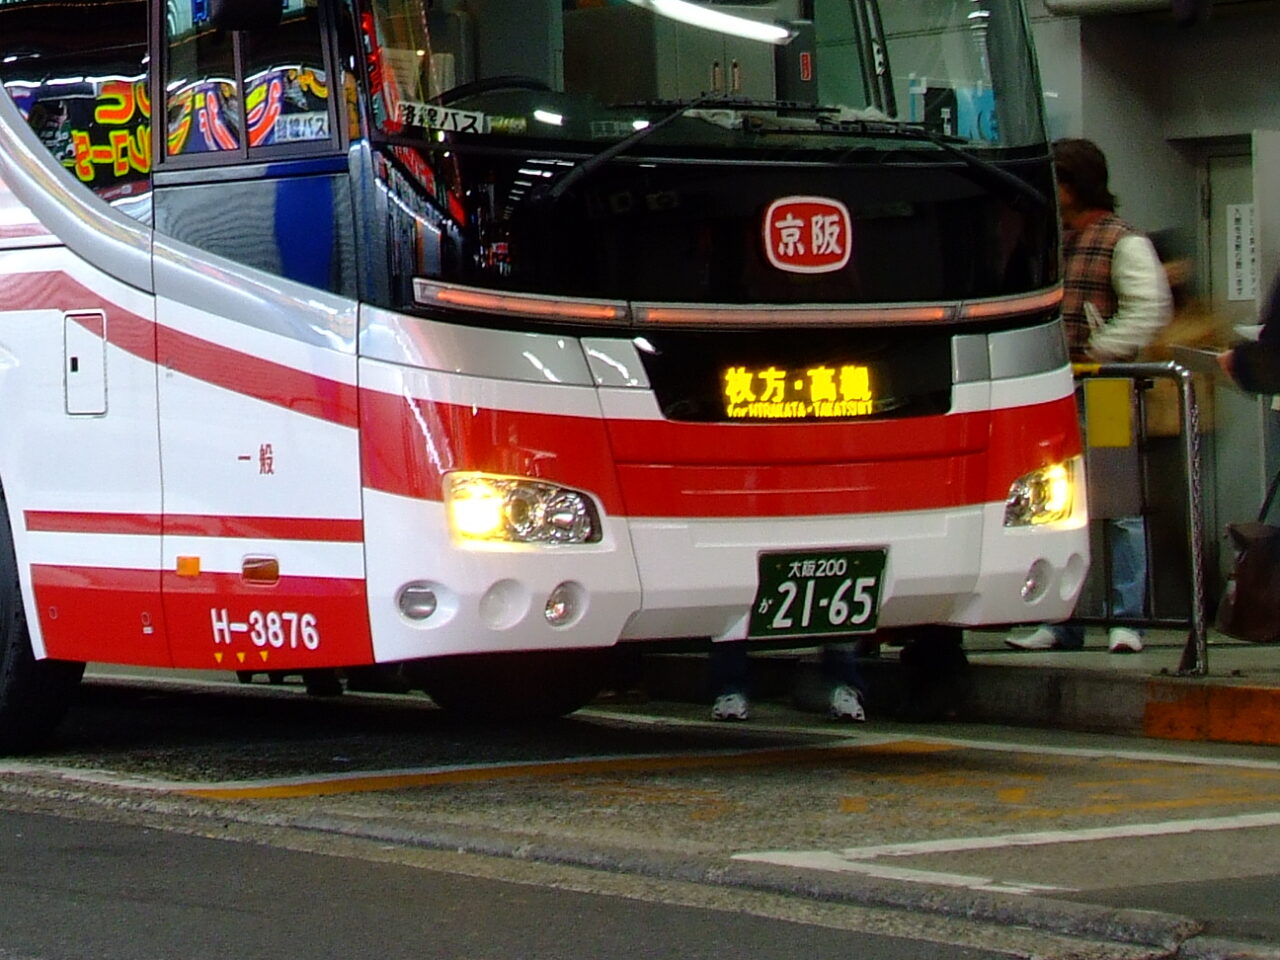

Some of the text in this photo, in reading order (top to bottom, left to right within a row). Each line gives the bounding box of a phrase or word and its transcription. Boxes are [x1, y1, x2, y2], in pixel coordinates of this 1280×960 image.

[775, 213, 843, 257] 京阪
[237, 443, 275, 475] 一般
[787, 558, 848, 577] 大阪200
[772, 575, 877, 629] 21-65
[210, 607, 321, 650] H-3876
